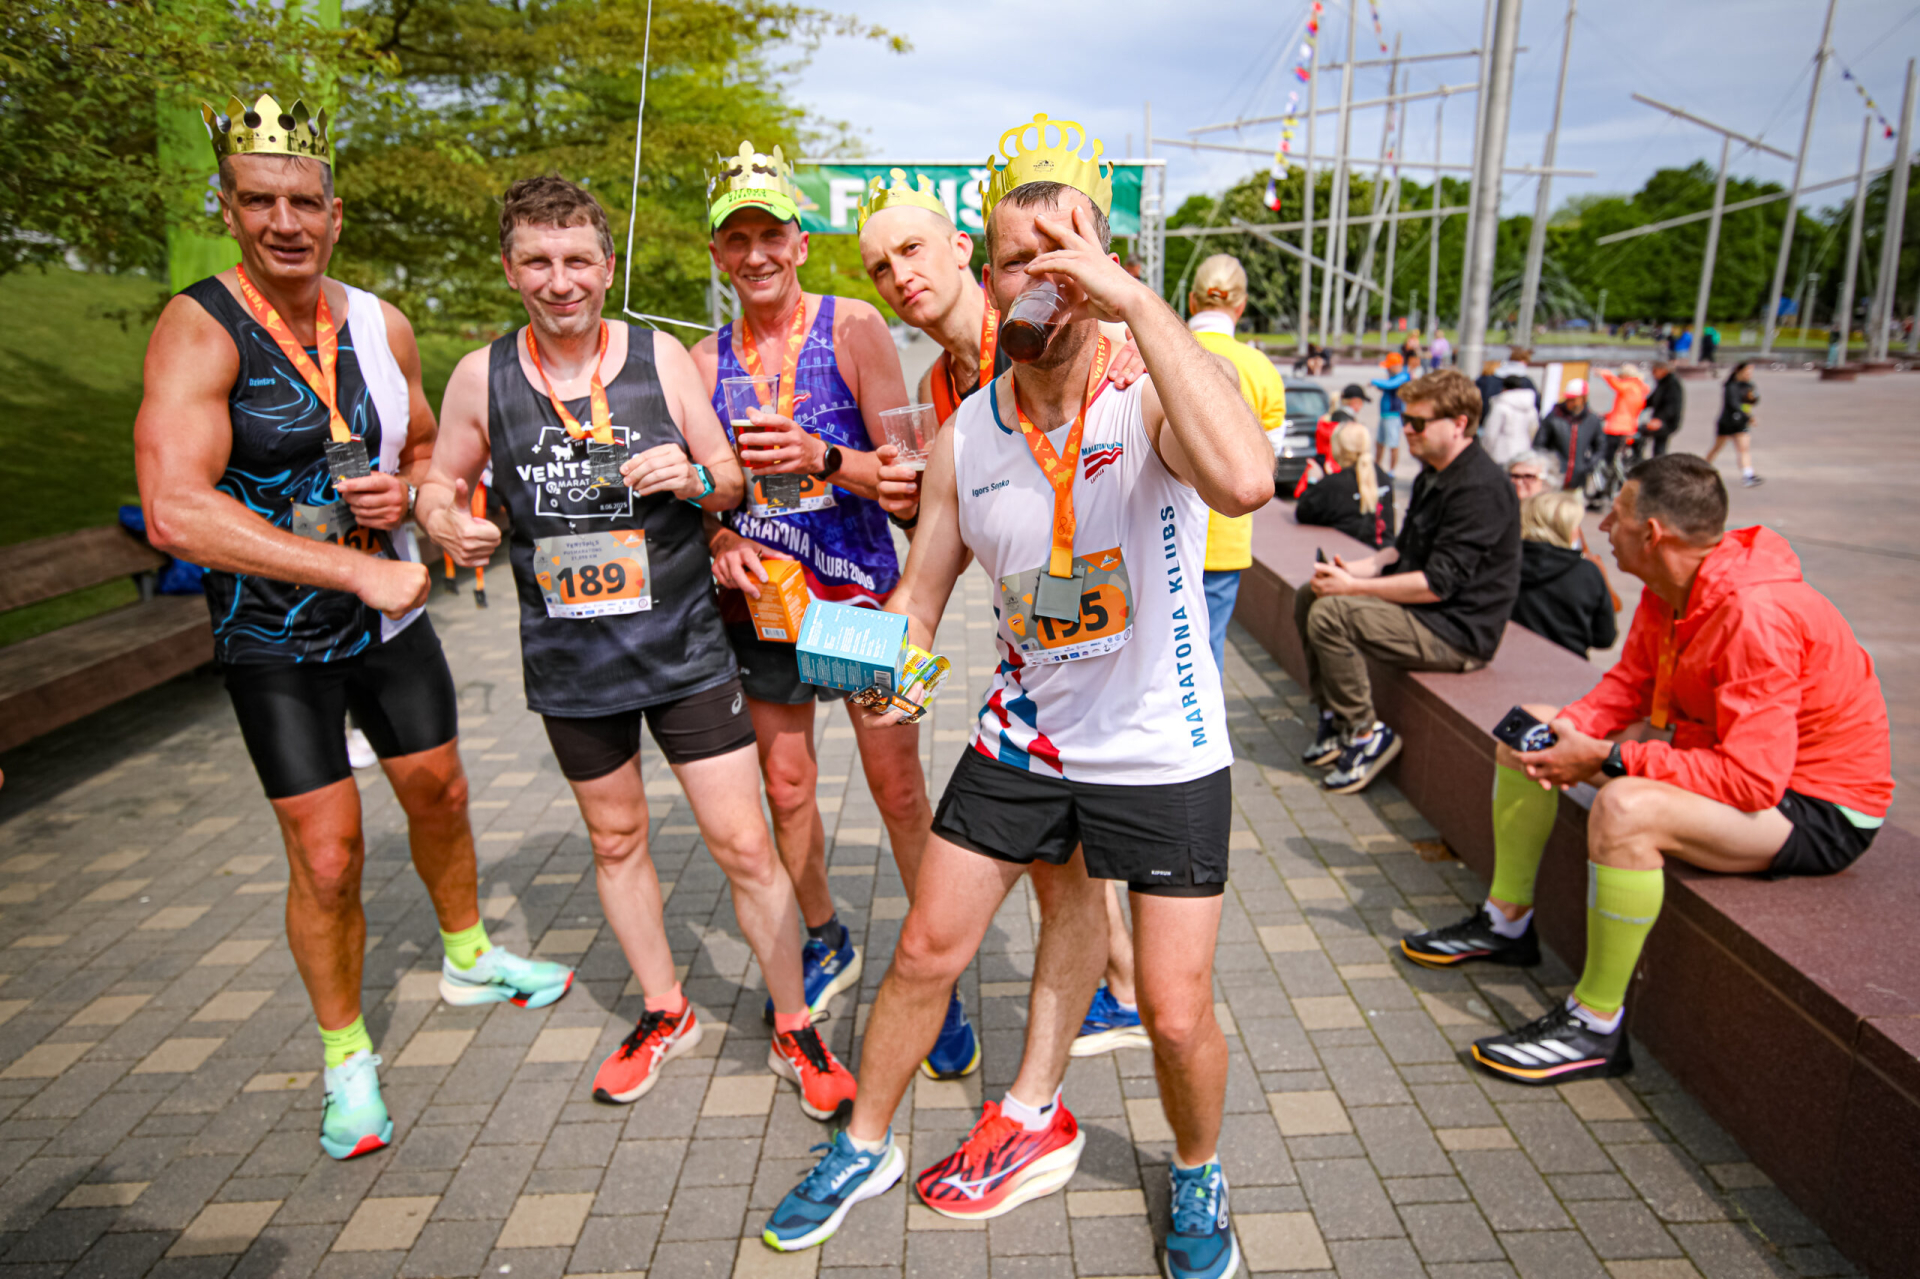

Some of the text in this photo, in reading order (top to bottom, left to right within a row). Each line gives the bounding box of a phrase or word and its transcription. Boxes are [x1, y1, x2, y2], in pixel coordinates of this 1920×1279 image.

[829, 168, 991, 228] FIŠ
[516, 459, 592, 483] VENTS
[558, 478, 591, 488] MARAT
[972, 487, 989, 498] Igors
[557, 563, 626, 598] 189
[814, 543, 849, 579] KLUBS
[849, 561, 876, 591] 2009
[1160, 505, 1208, 748] MARATONA KLUBS
